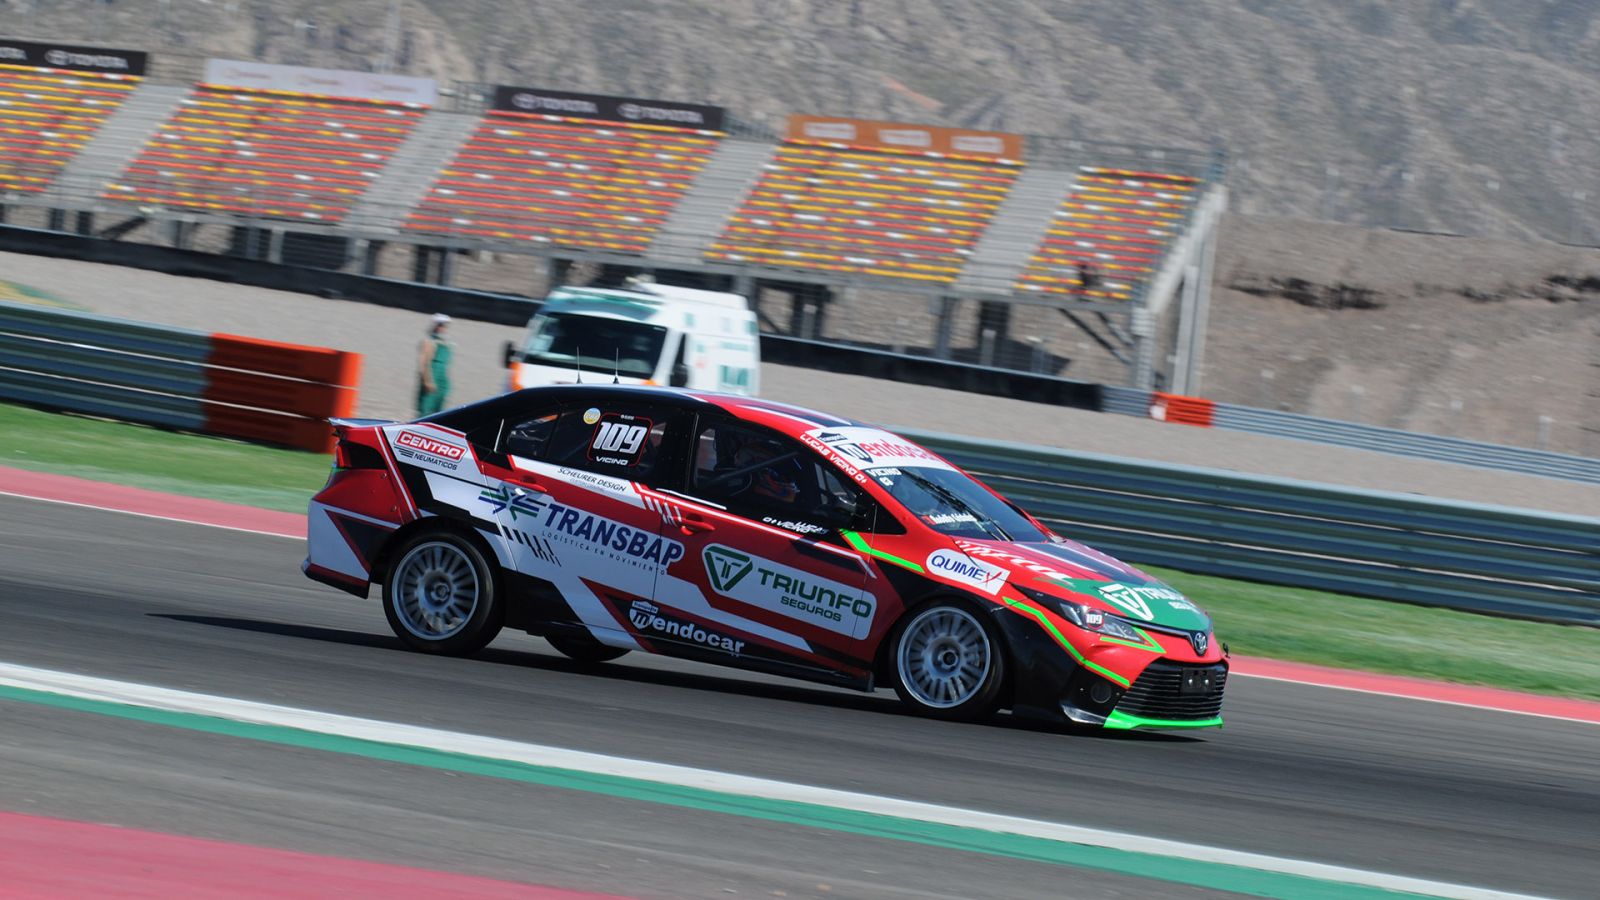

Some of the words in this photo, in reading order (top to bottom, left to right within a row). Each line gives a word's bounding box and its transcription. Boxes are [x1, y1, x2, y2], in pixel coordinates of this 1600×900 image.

[535, 96, 599, 114] TOYOTA
[640, 106, 704, 124] TOYOTA
[400, 432, 461, 458] CENTRO
[593, 421, 648, 454] 109
[414, 452, 458, 471] NEUMATICOS
[596, 456, 629, 466] VICINO
[800, 433, 831, 456] LUCAS
[829, 453, 859, 476] VICINO
[558, 466, 597, 483] SCHEURER
[597, 479, 627, 492] DESIGN
[545, 503, 684, 567] TRANSBAP
[594, 548, 604, 556] EN
[931, 554, 1003, 586] QUIMEX
[758, 567, 872, 619] TRIUNFO
[780, 595, 842, 622] SEGUROS
[1086, 613, 1103, 625] 109
